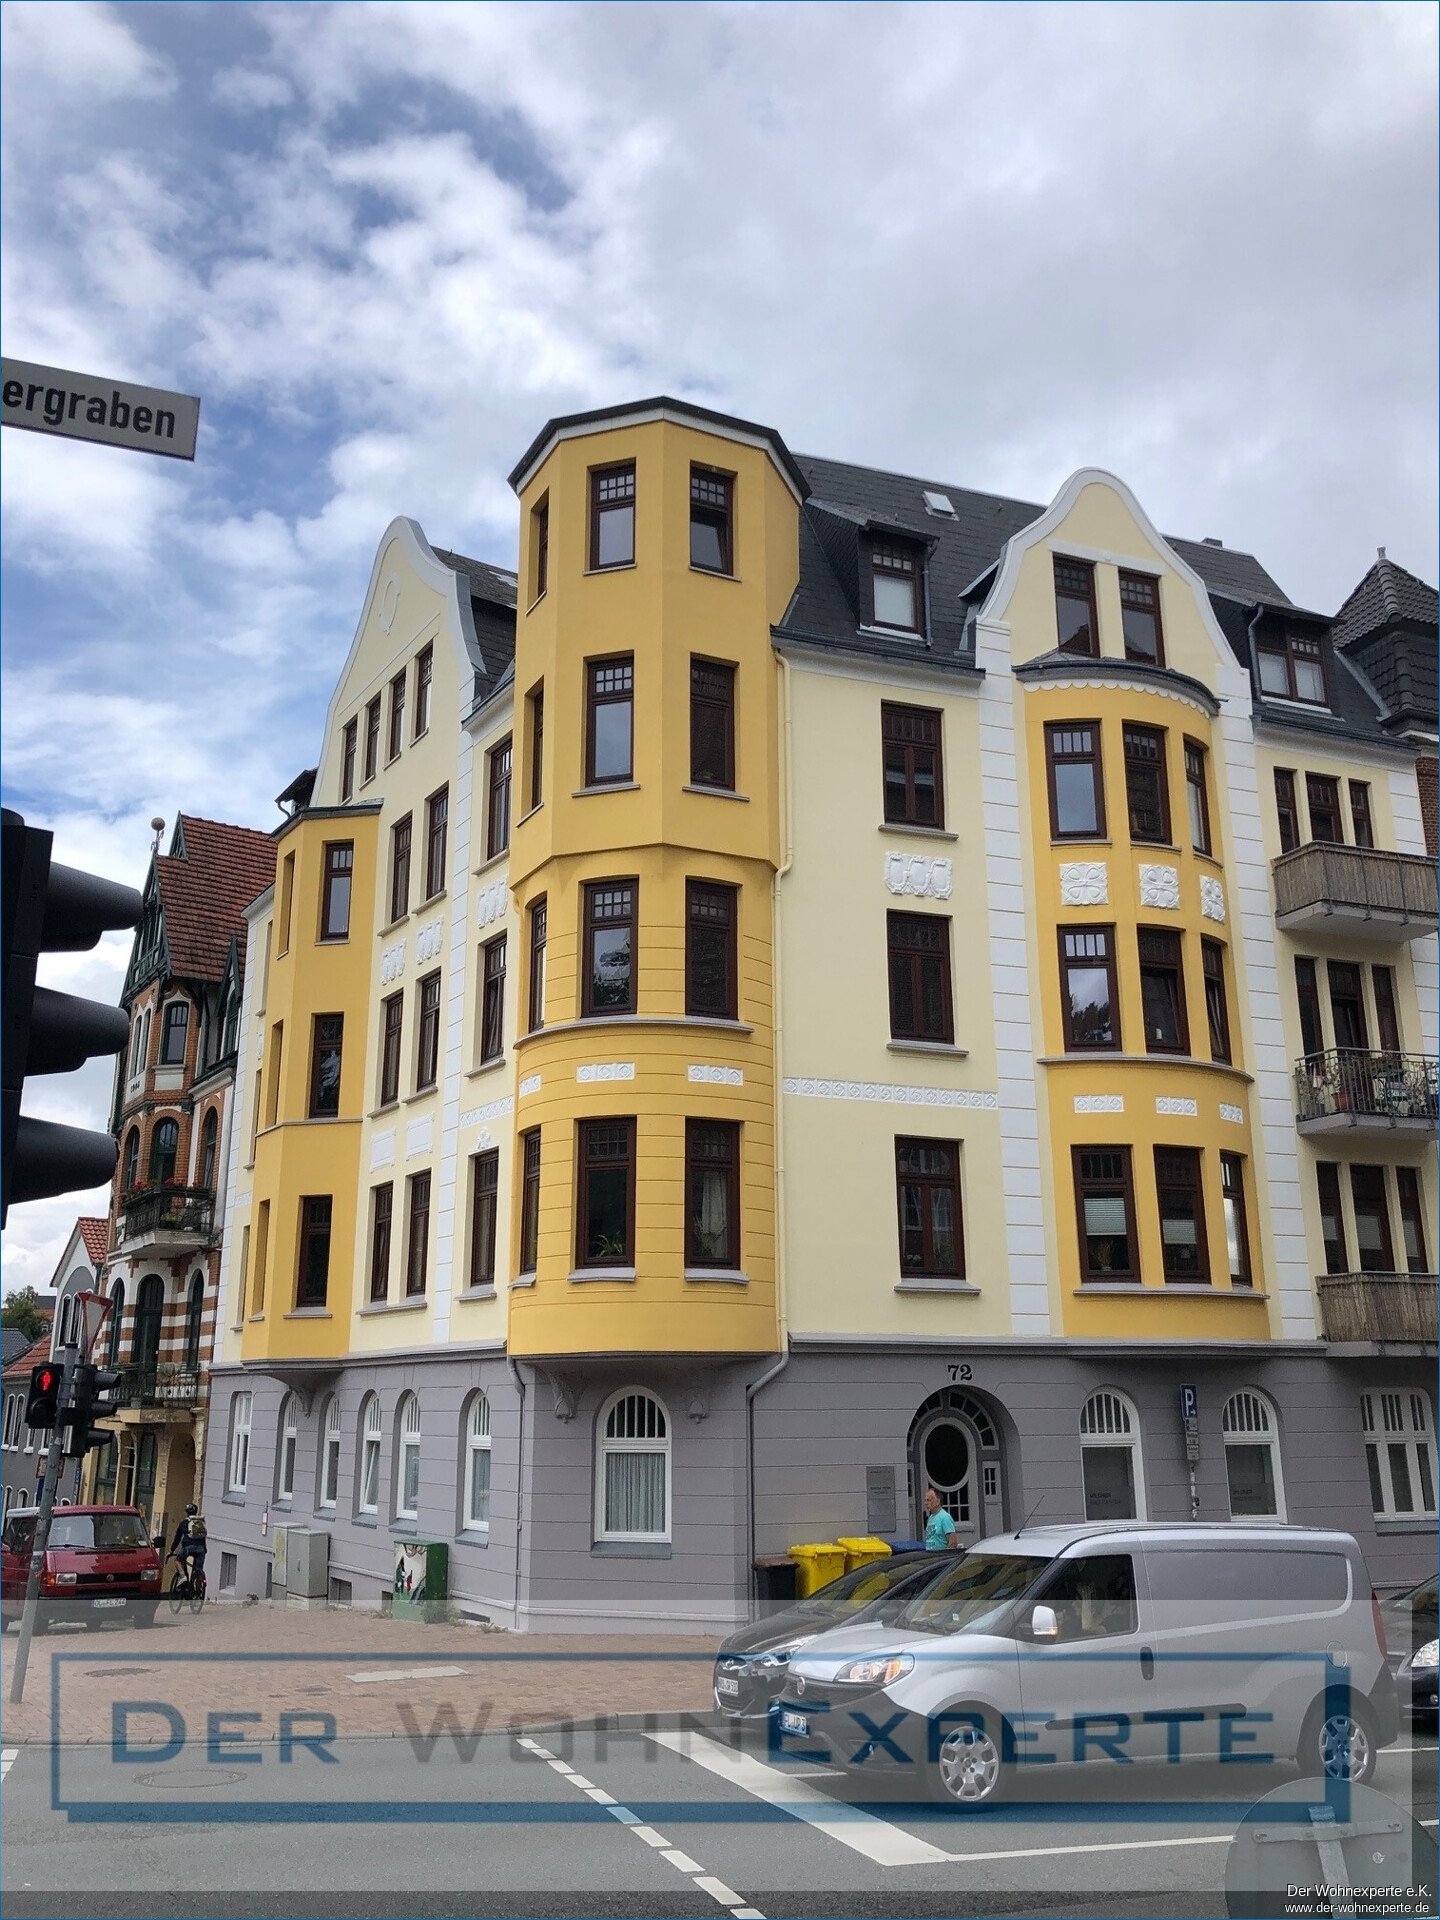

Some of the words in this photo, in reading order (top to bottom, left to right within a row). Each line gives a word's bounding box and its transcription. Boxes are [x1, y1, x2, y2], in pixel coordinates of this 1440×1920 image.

[2, 380, 176, 439] ergraben
[947, 1364, 973, 1381] 72
[1185, 1389, 1194, 1416] P
